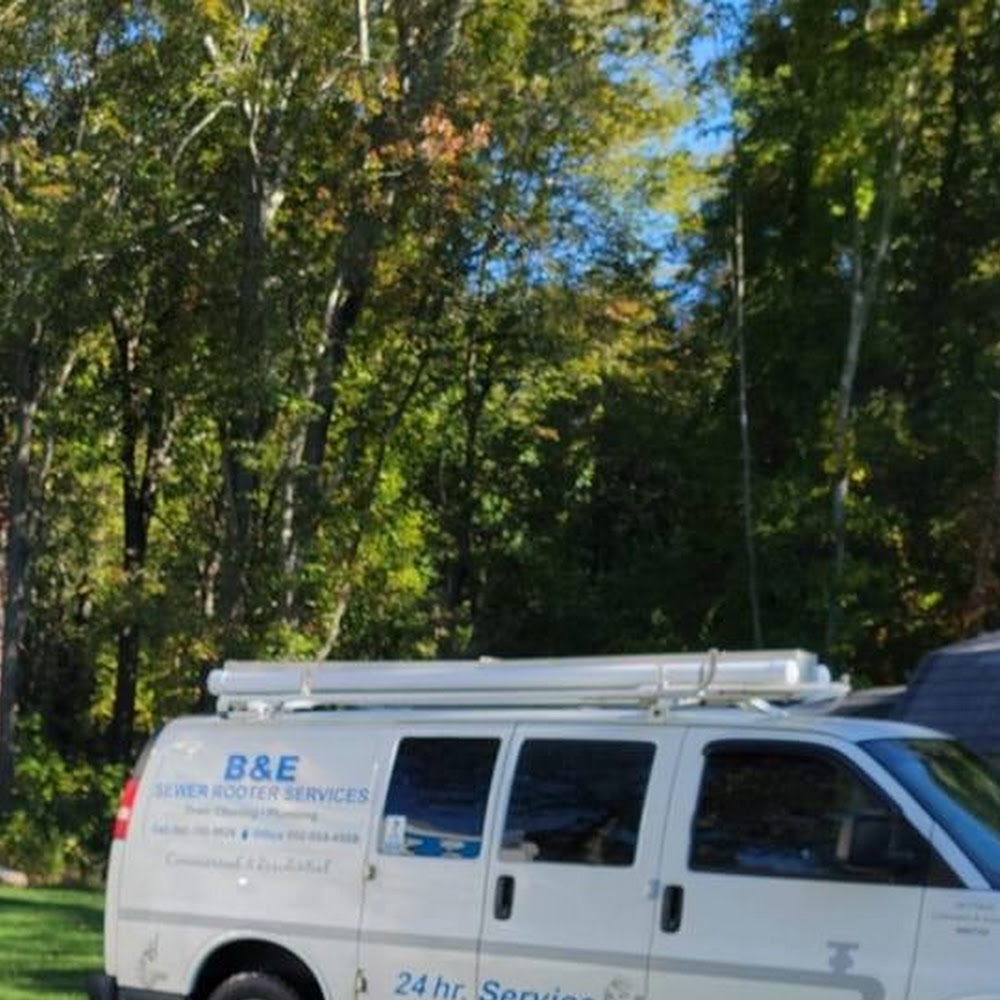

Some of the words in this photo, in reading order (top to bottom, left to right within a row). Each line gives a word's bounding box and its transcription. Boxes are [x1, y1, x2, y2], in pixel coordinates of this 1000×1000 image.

[224, 754, 300, 782] B&E
[154, 782, 208, 799] SEWER
[211, 784, 281, 801] ROOTER
[284, 786, 370, 803] SERVICES
[394, 970, 427, 997] 24
